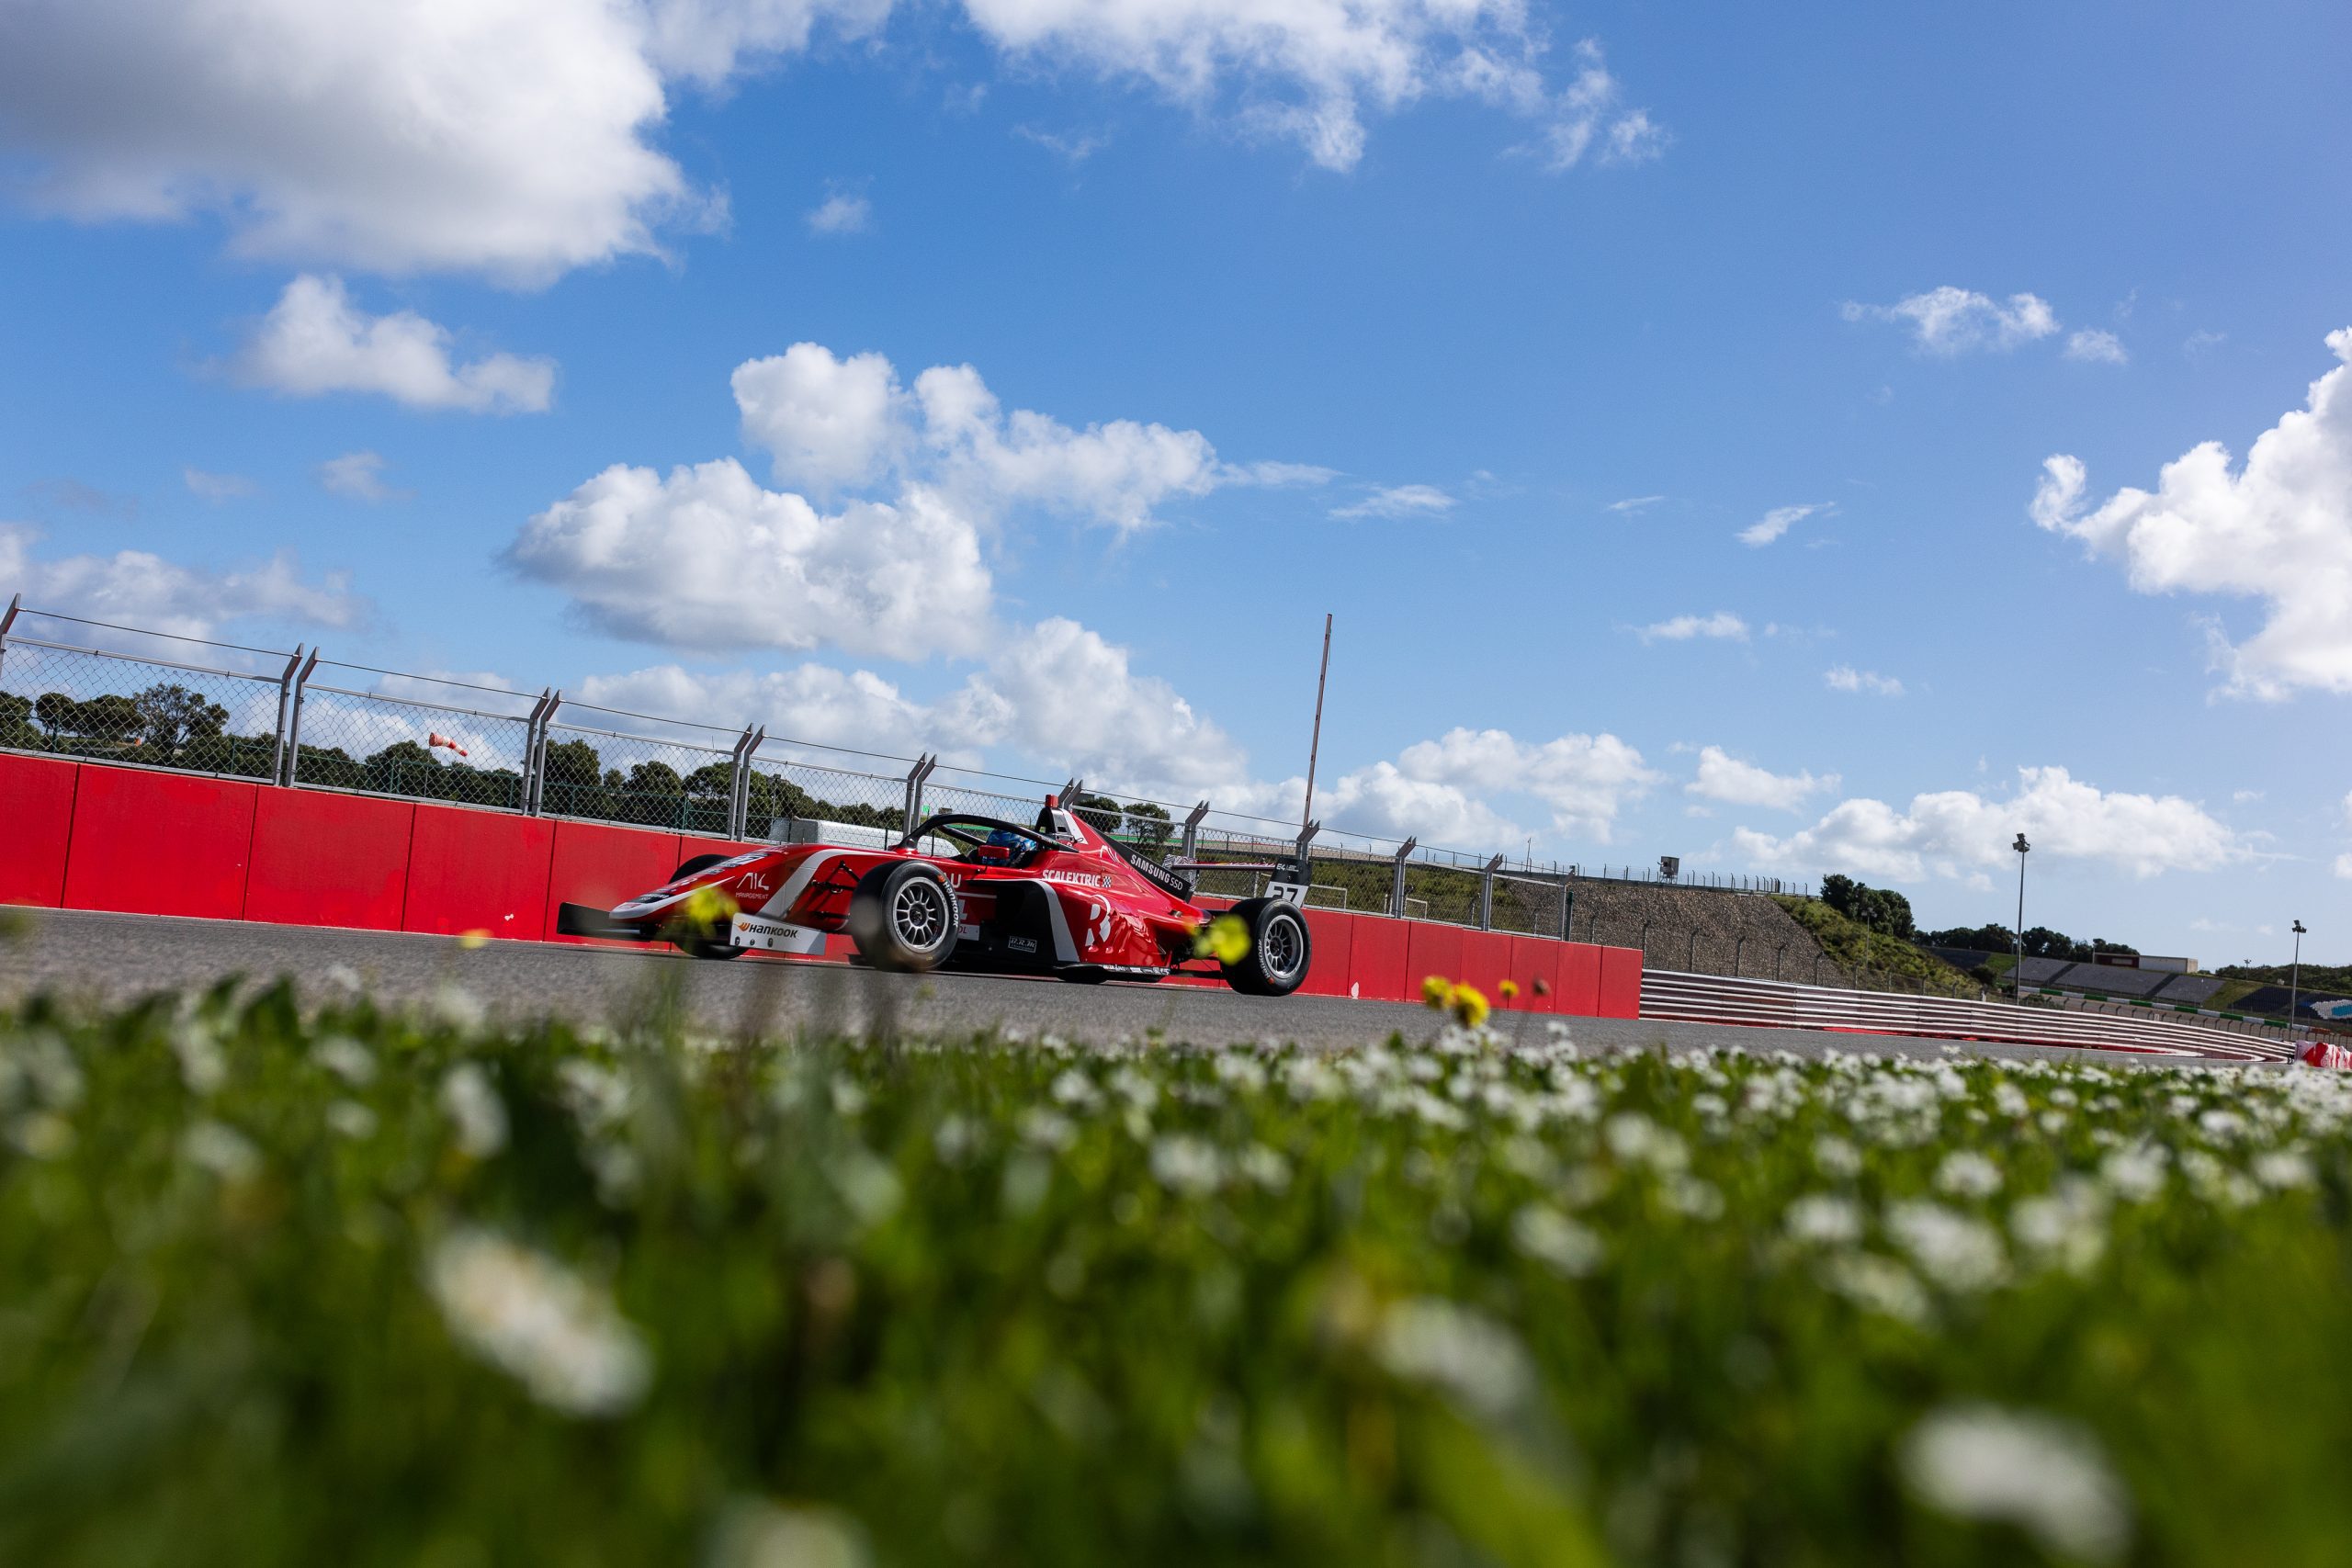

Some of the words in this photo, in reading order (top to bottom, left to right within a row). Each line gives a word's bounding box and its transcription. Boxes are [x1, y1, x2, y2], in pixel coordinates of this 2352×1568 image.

[1042, 869, 1102, 888] SCALEXTRIC
[1130, 853, 1170, 884] SAMSUNG
[1170, 874, 1183, 891] SSD
[1272, 886, 1299, 903] 27
